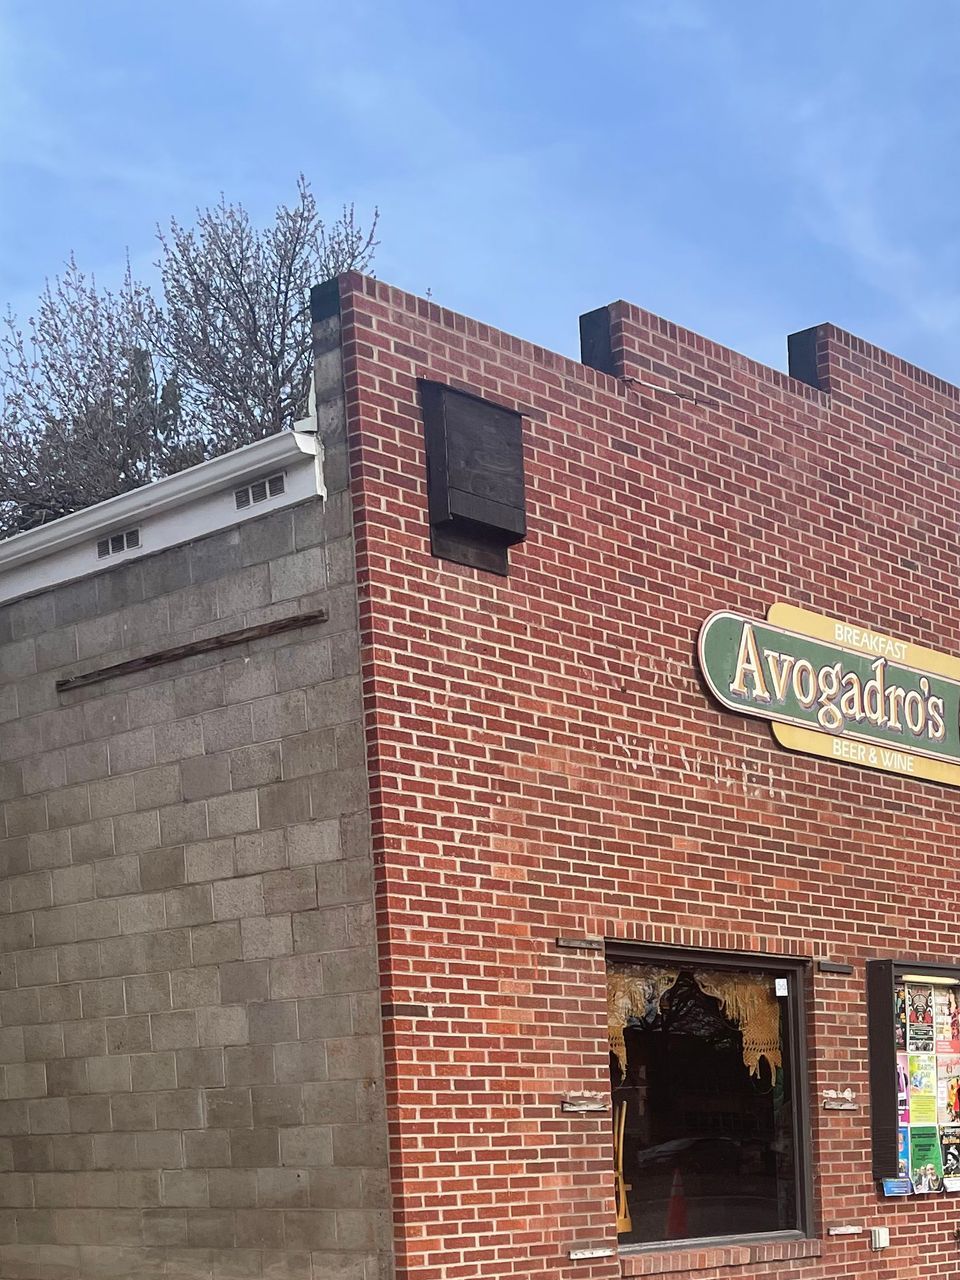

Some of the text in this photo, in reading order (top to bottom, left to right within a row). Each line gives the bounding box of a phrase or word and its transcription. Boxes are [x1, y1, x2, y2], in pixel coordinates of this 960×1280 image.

[834, 623, 908, 660] BREAKFAST
[729, 621, 946, 741] Avogadro's
[833, 738, 914, 772] BEER & WINE
